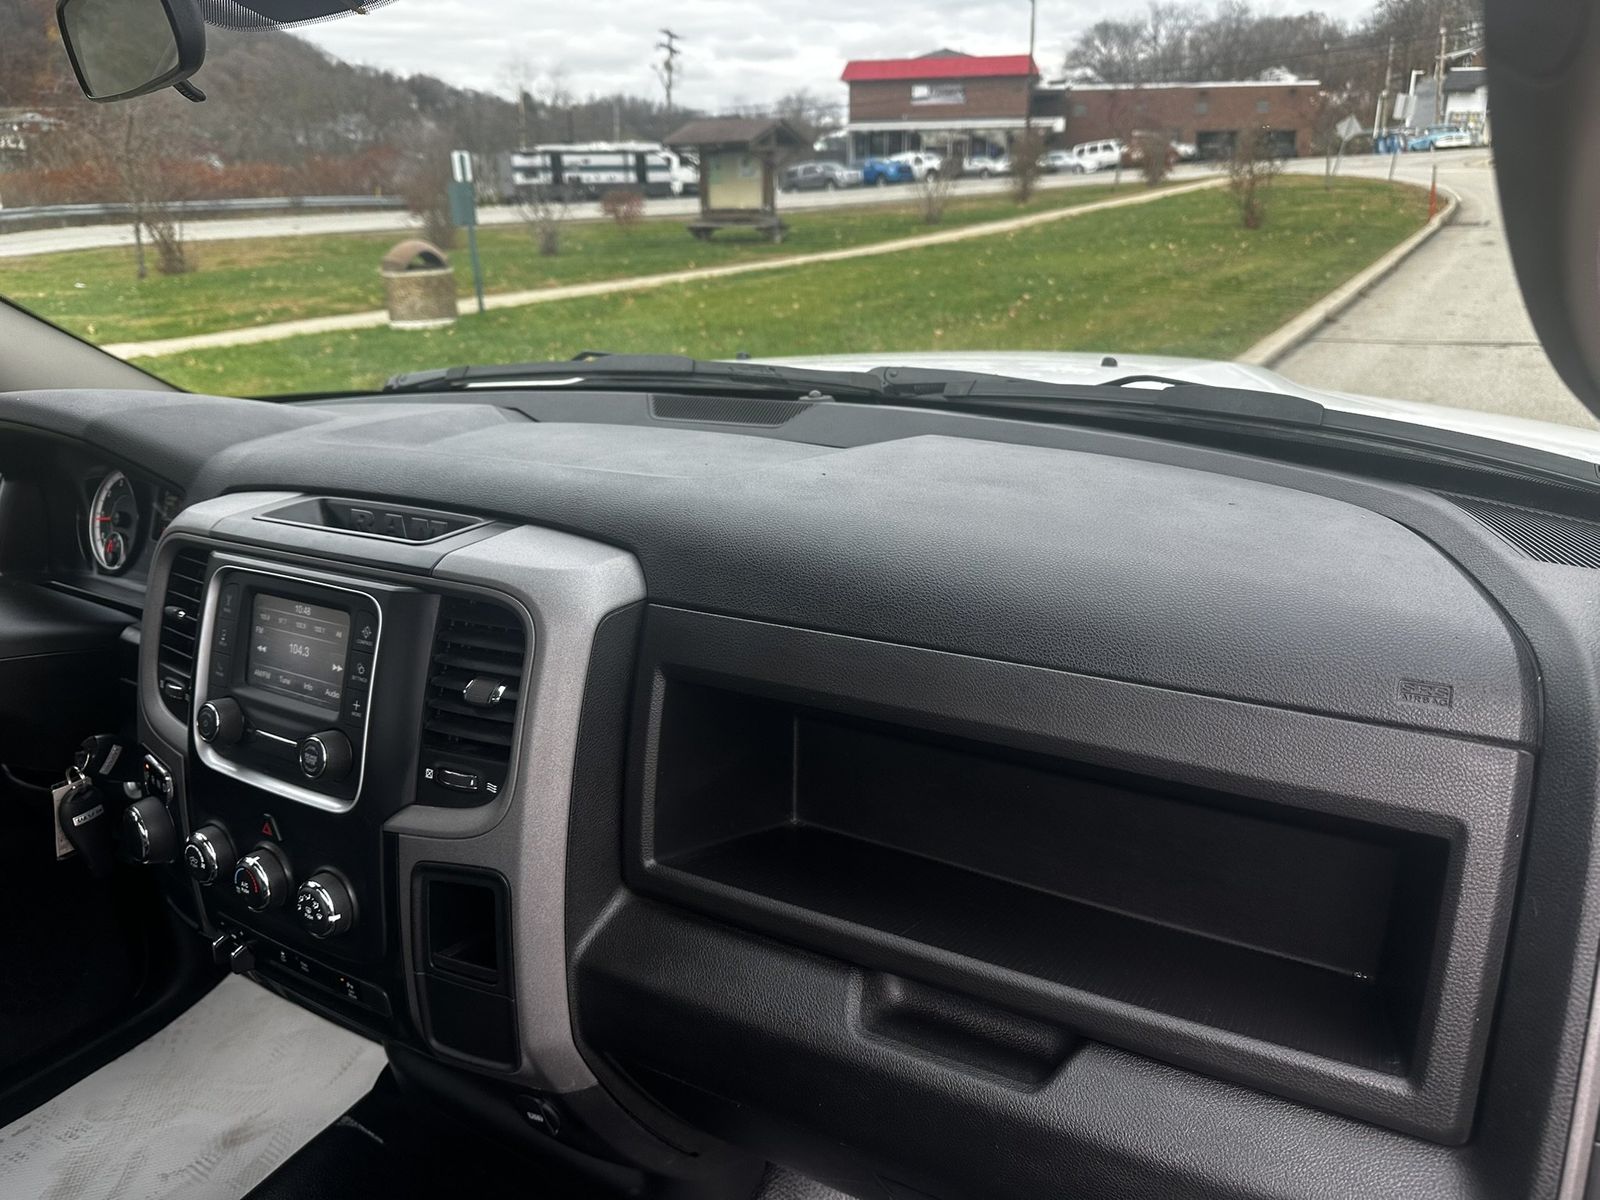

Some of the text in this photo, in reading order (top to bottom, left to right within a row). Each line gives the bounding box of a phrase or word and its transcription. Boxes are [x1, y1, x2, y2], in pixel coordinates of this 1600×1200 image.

[289, 643, 310, 657] 104.3
[324, 688, 340, 699] Audio
[1401, 693, 1449, 706] AIRBAG
